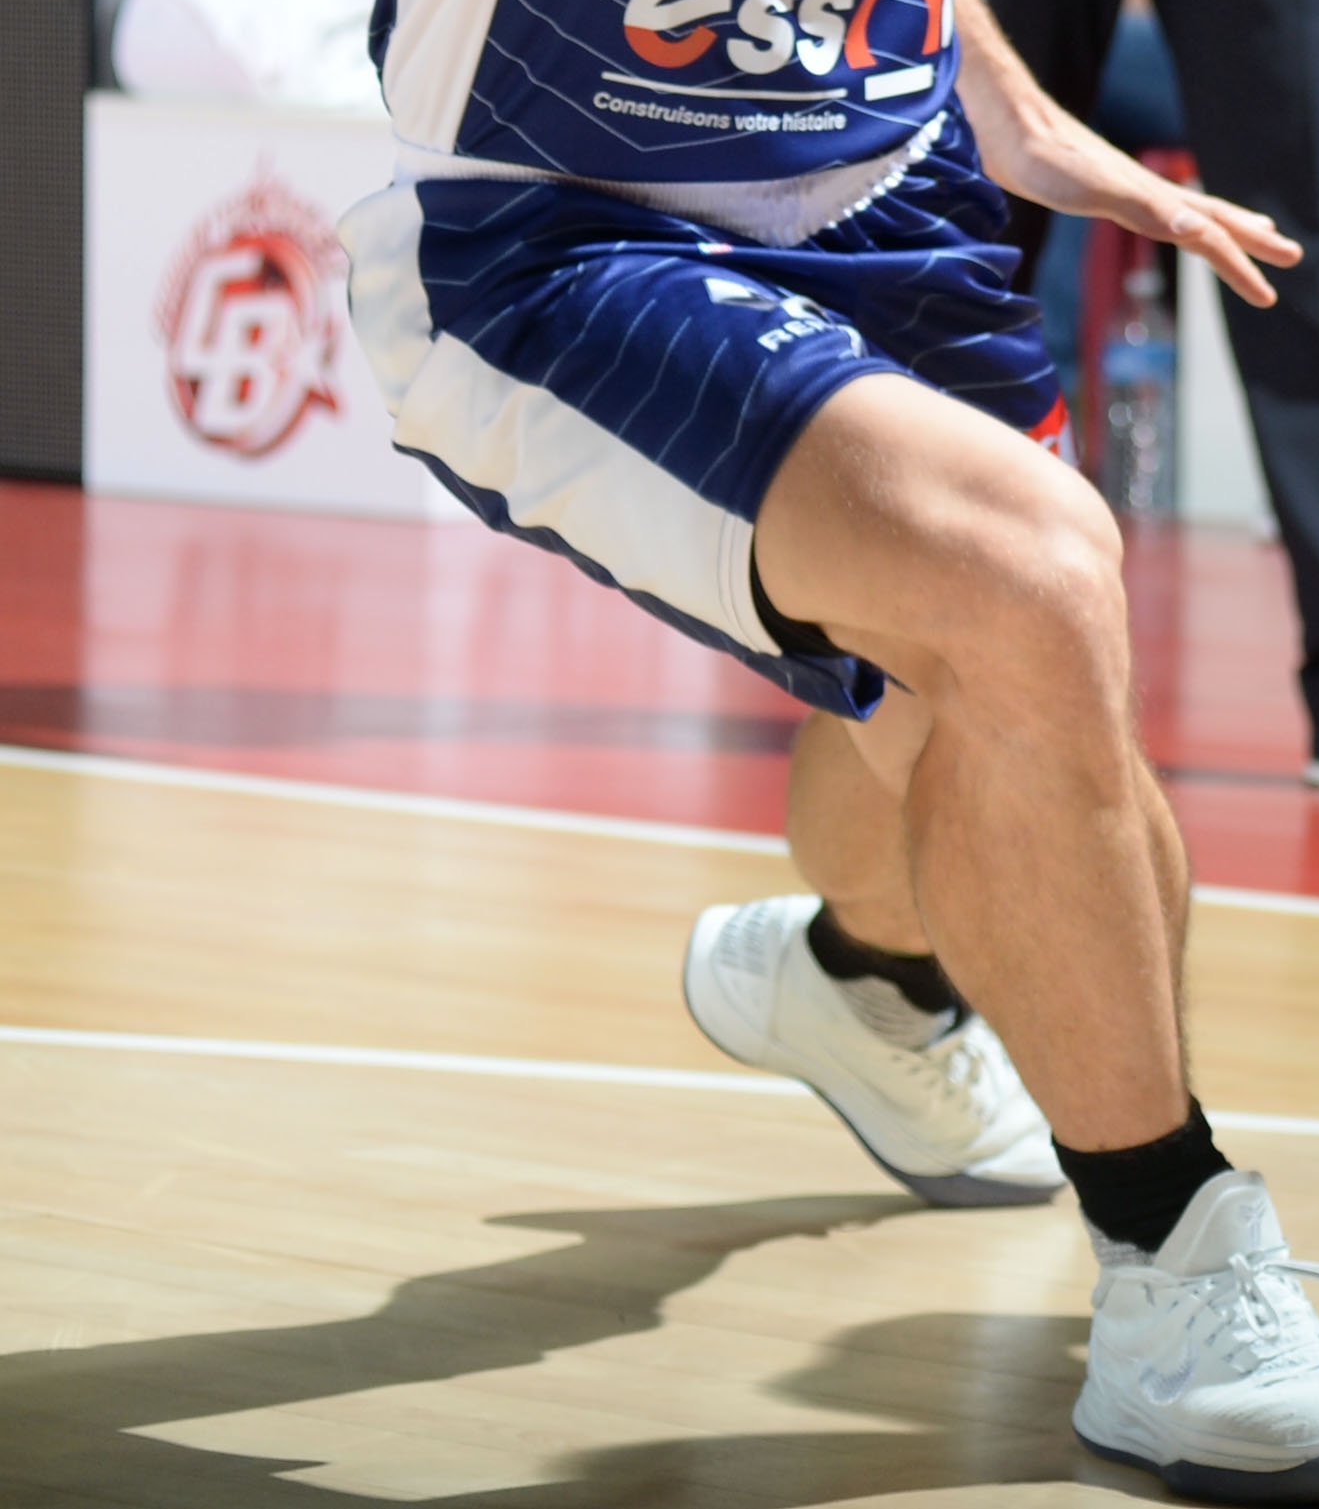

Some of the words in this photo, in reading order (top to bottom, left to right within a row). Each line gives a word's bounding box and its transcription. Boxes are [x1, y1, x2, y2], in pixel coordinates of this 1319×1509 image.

[593, 90, 730, 129] Construisons
[734, 113, 780, 132] votre
[782, 111, 847, 132] histoire
